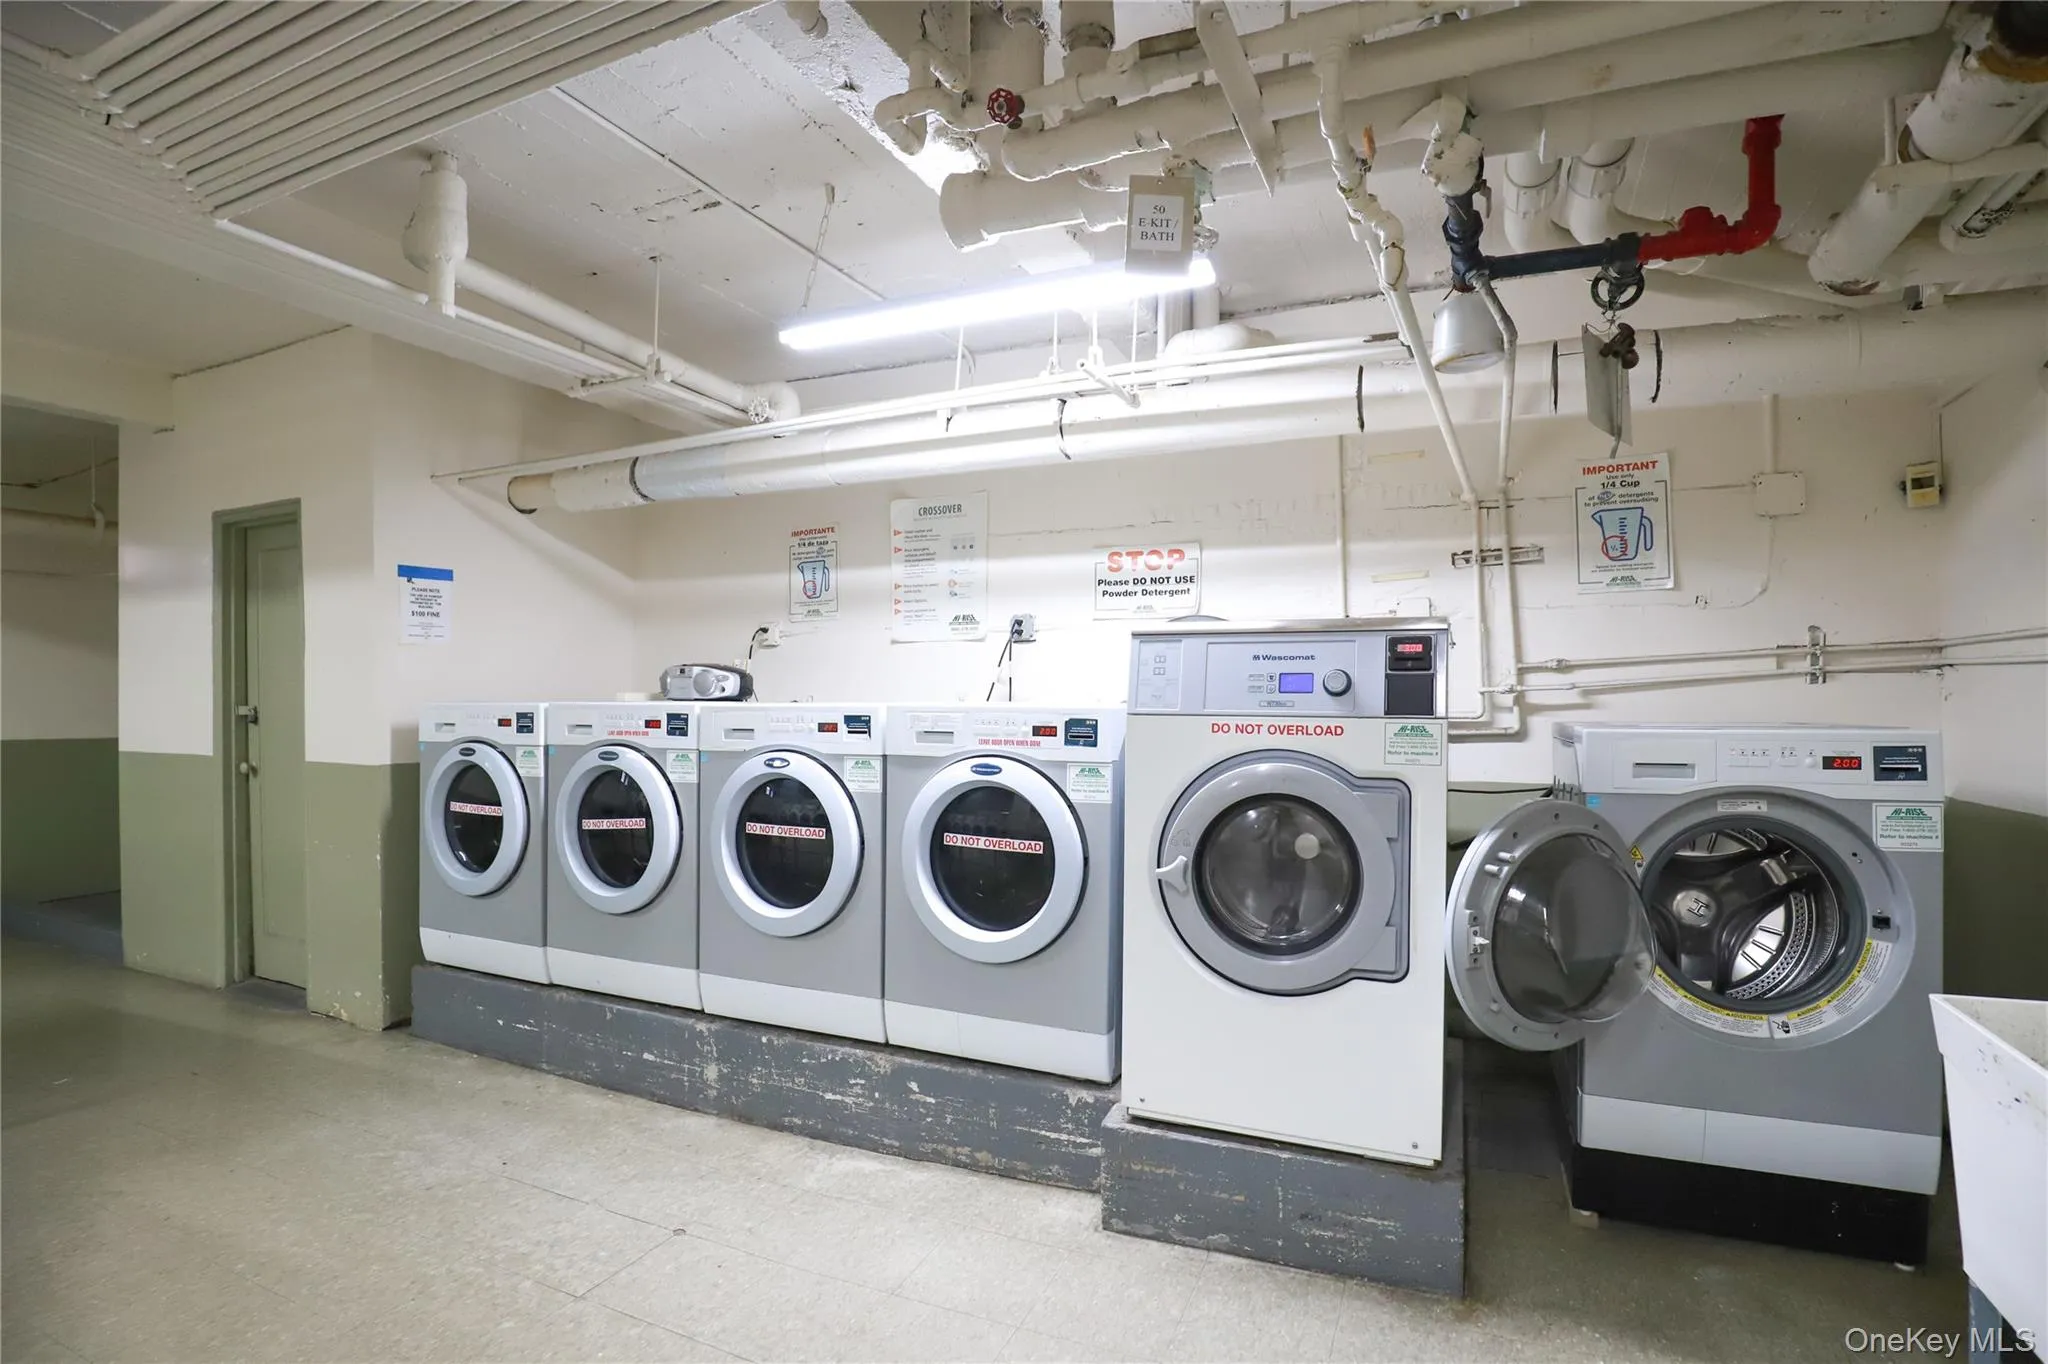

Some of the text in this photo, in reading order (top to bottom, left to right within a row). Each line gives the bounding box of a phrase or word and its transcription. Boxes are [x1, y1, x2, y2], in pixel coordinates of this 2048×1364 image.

[1153, 205, 1166, 214] 50
[1140, 231, 1175, 241] BATH
[1582, 460, 1658, 476] IMPORTANT
[1601, 480, 1640, 489] 1/4 Cup
[1592, 499, 1617, 507] prevent
[918, 504, 962, 516] CROSSOVER
[791, 527, 836, 538] IMPORTANTE
[1107, 548, 1185, 573] STOP
[1097, 575, 1196, 587] Please DO NOT USE
[1102, 587, 1190, 598] Powder Detergent
[1211, 723, 1344, 736] DO NOT OVERLOAD
[469, 805, 502, 815] OVERLOAD
[1891, 808, 1928, 816] HI-RISE
[583, 819, 644, 828] DO NOT OVERLOAD
[747, 823, 824, 837] DO NOT OVERLOAD
[945, 834, 1041, 852] DO NOT OVERLOAD
